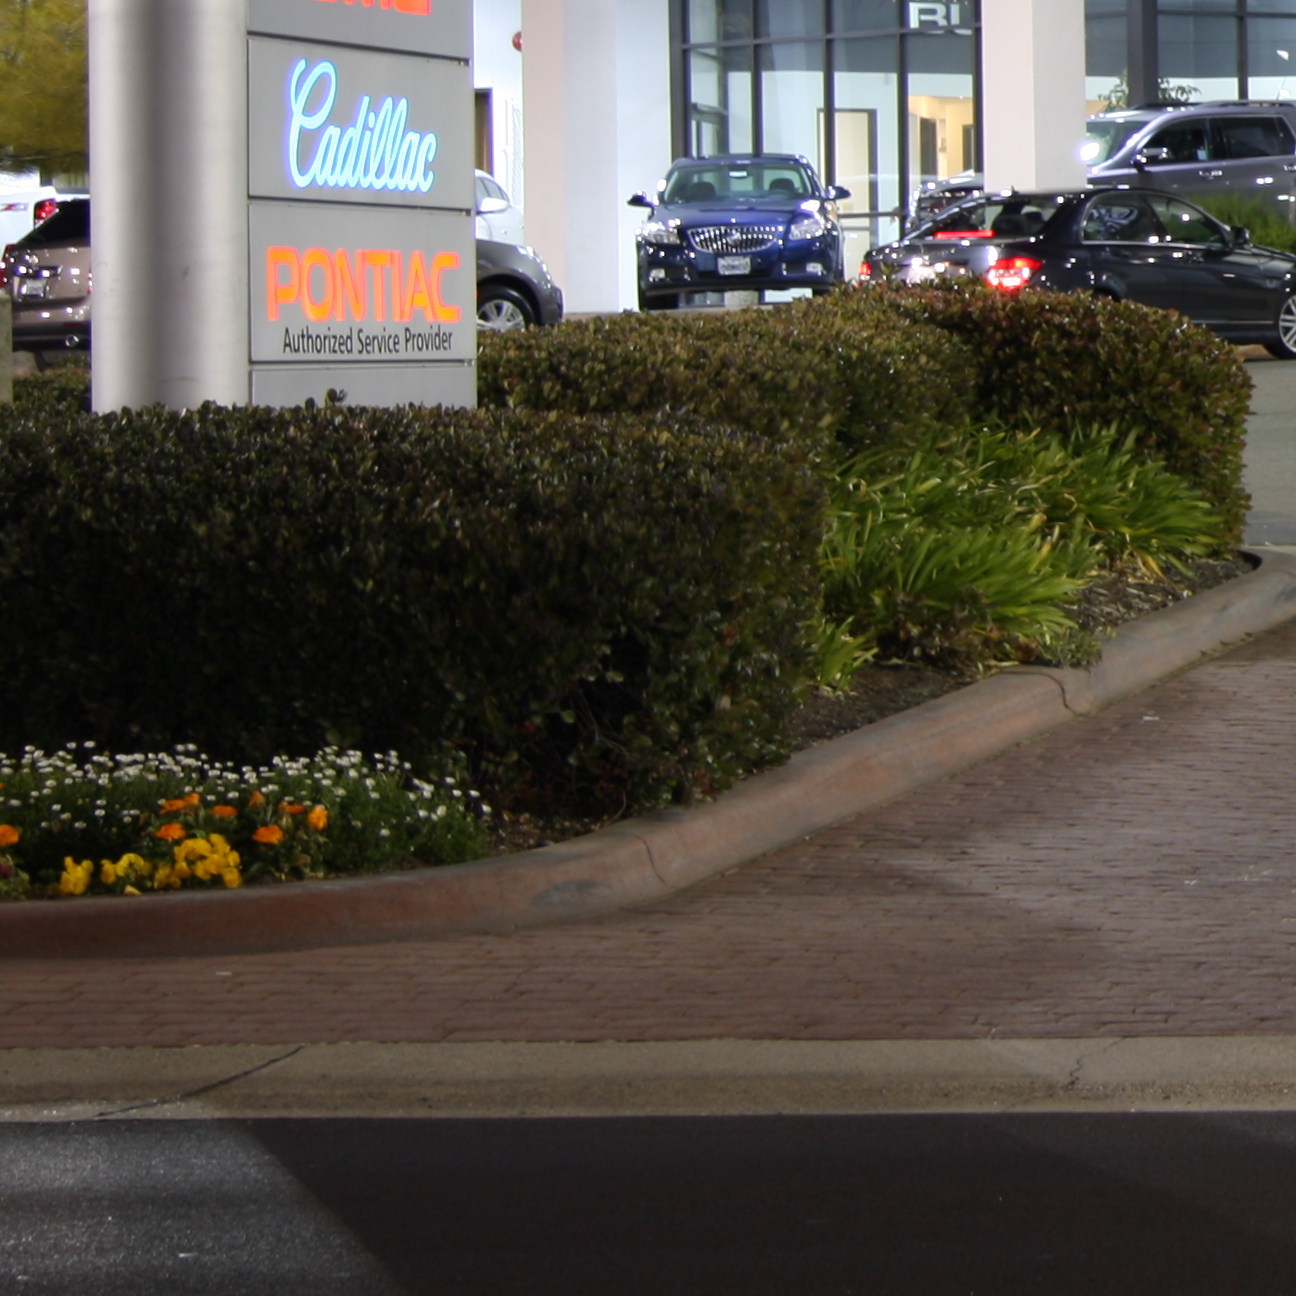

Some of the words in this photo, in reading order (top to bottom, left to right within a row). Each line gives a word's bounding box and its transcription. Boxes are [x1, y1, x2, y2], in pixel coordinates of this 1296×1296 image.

[289, 58, 439, 193] Cadillac
[267, 245, 461, 323] PONTIAC
[283, 325, 353, 354] Authorized
[357, 326, 400, 355] Service
[404, 324, 453, 352] Provider
